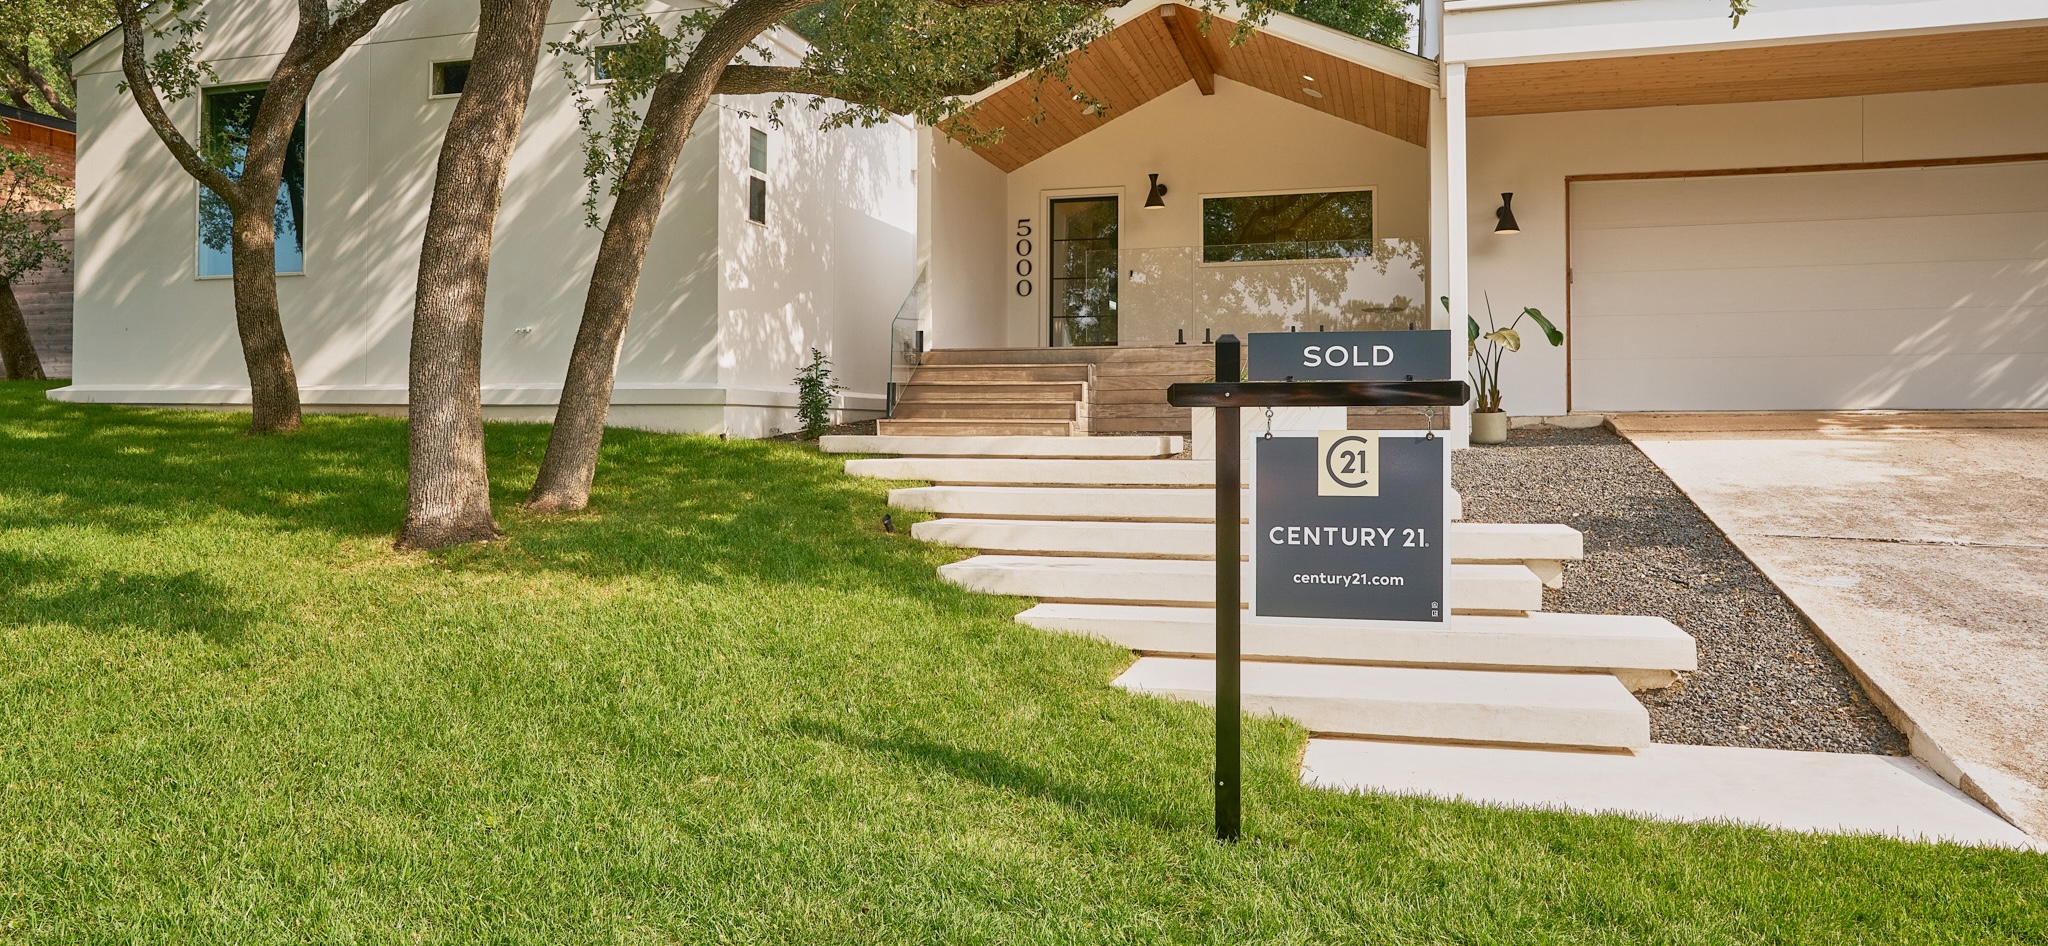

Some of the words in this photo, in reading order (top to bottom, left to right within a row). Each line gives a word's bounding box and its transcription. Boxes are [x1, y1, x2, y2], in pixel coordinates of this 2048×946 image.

[1016, 218, 1033, 297] 5000
[1303, 345, 1394, 367] SOLD
[1269, 526, 1396, 547] CENTURY
[1293, 572, 1404, 588] century21.com
